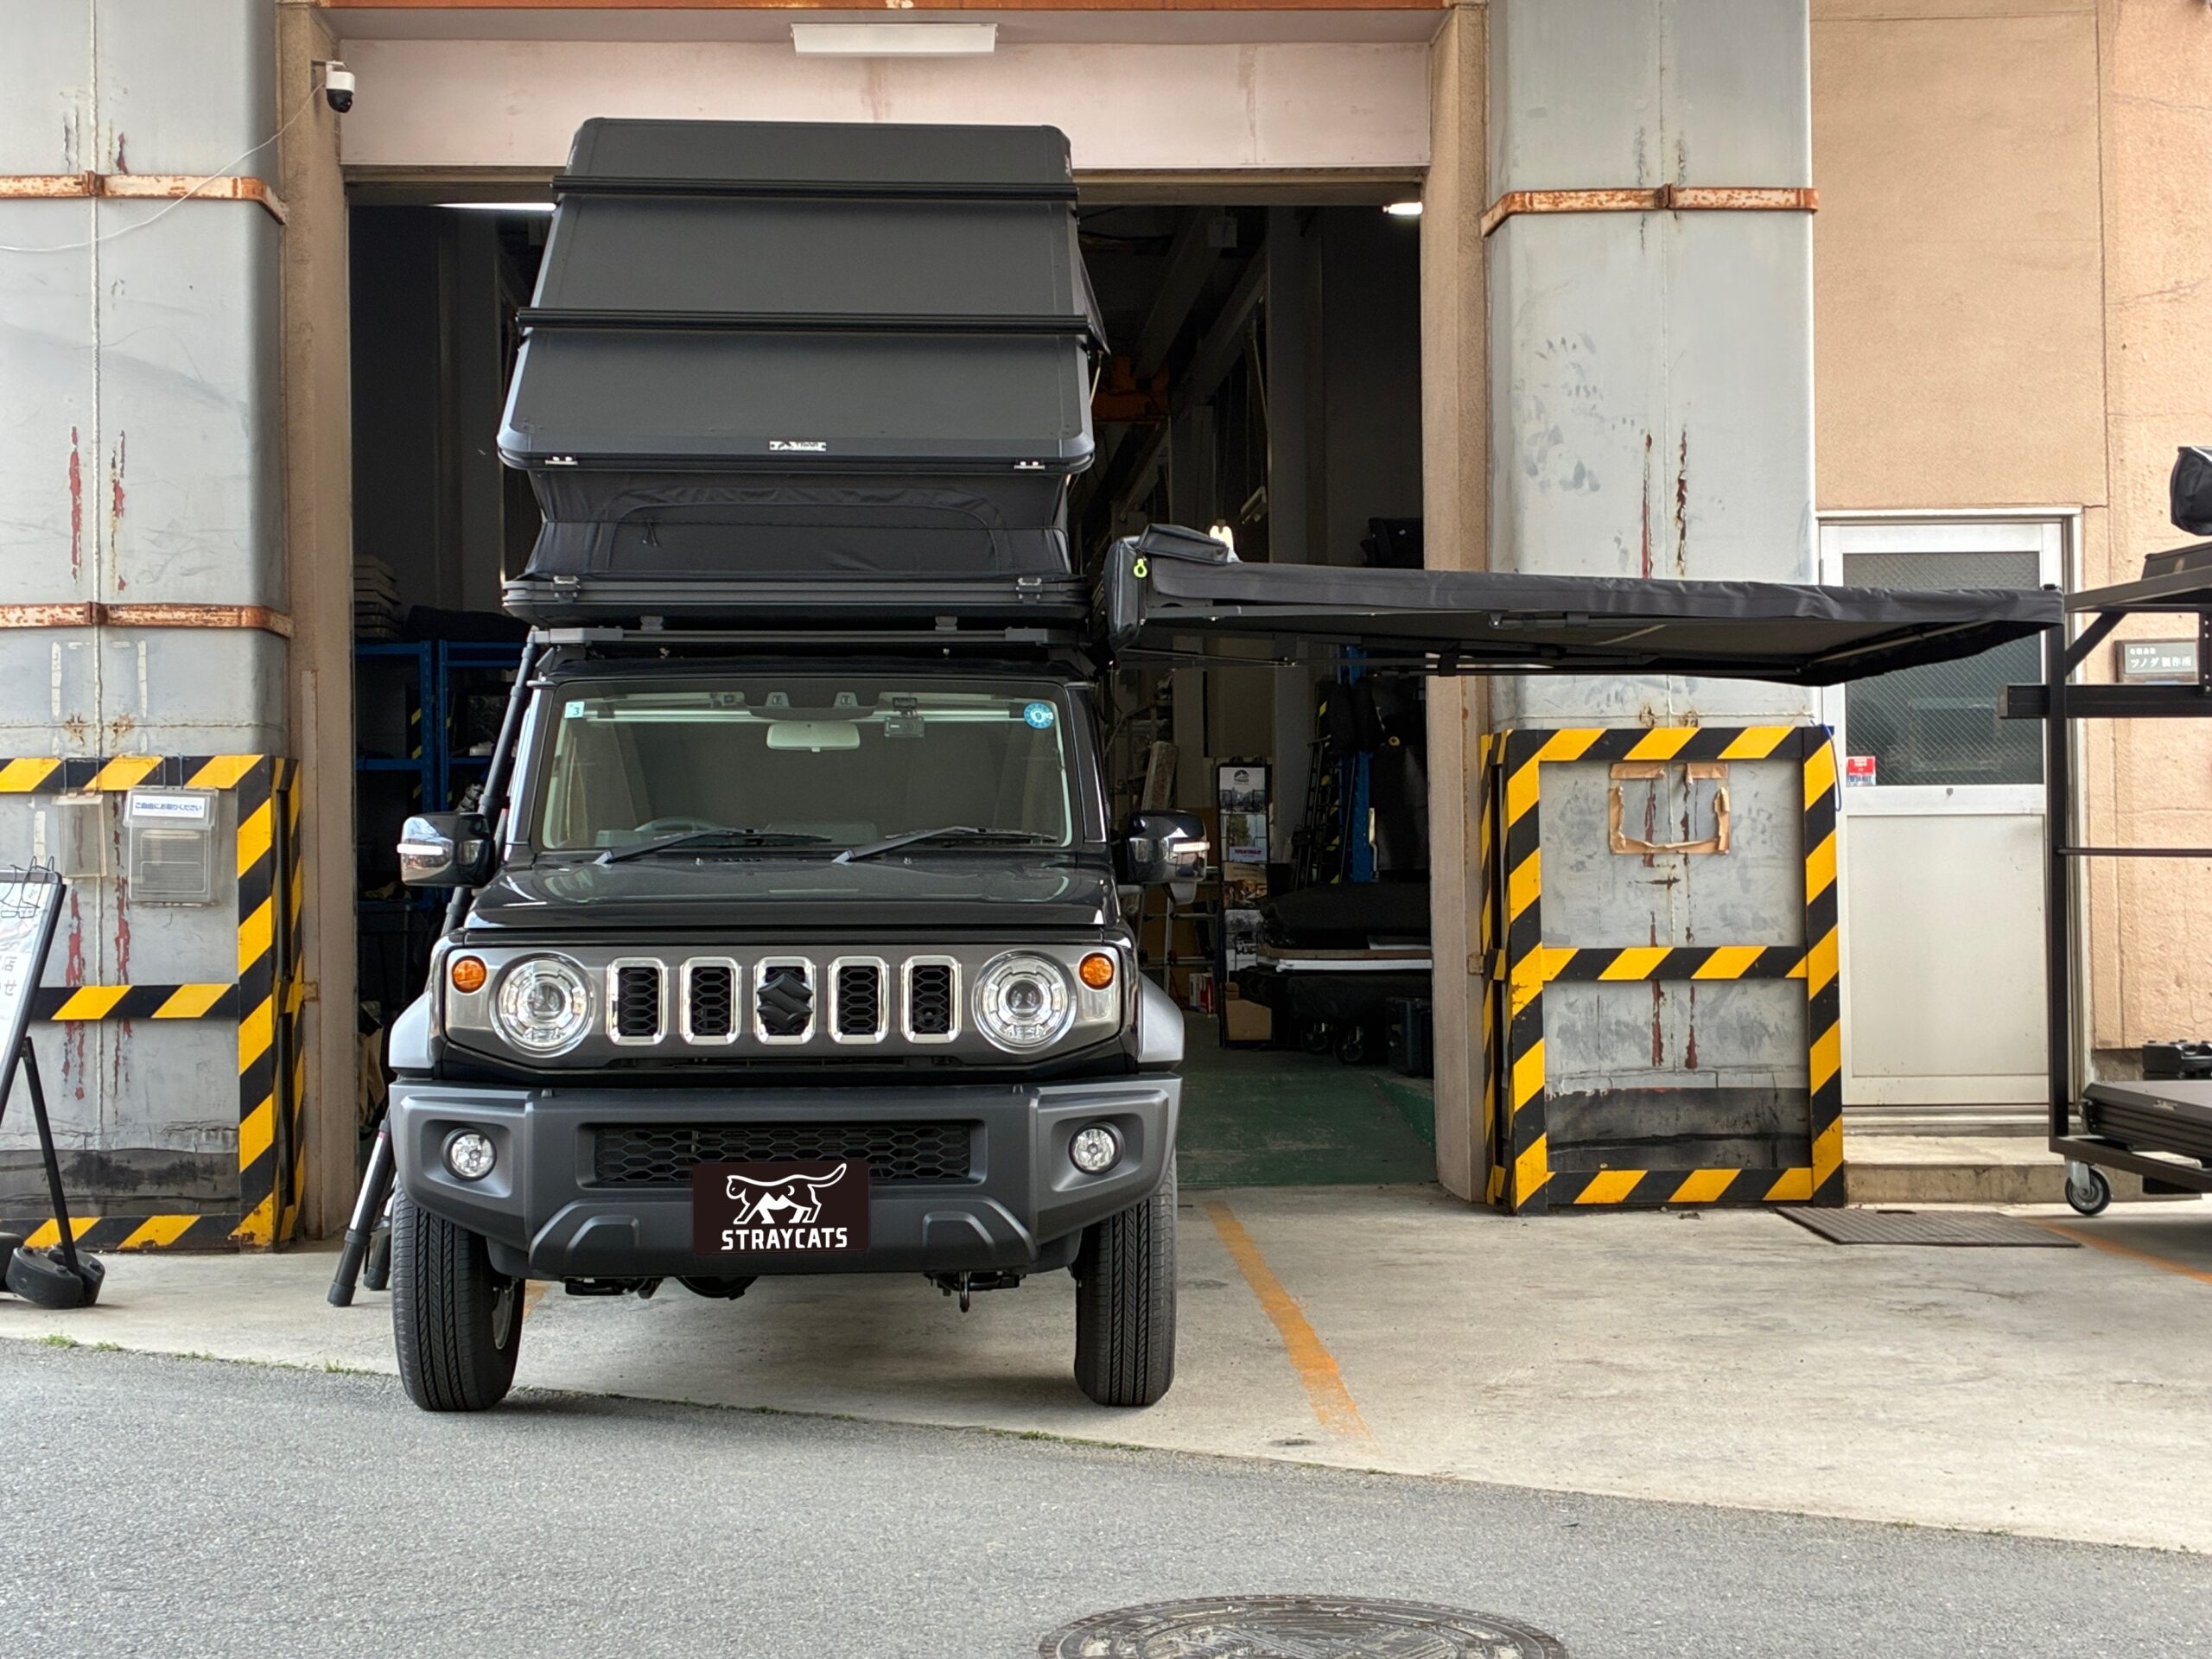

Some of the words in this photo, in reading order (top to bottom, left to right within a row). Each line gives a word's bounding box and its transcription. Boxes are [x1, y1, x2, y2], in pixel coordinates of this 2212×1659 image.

[573, 707, 580, 715] 3
[135, 802, 202, 810] ご自由にお取りください
[721, 1227, 848, 1250] STRAYCATS
